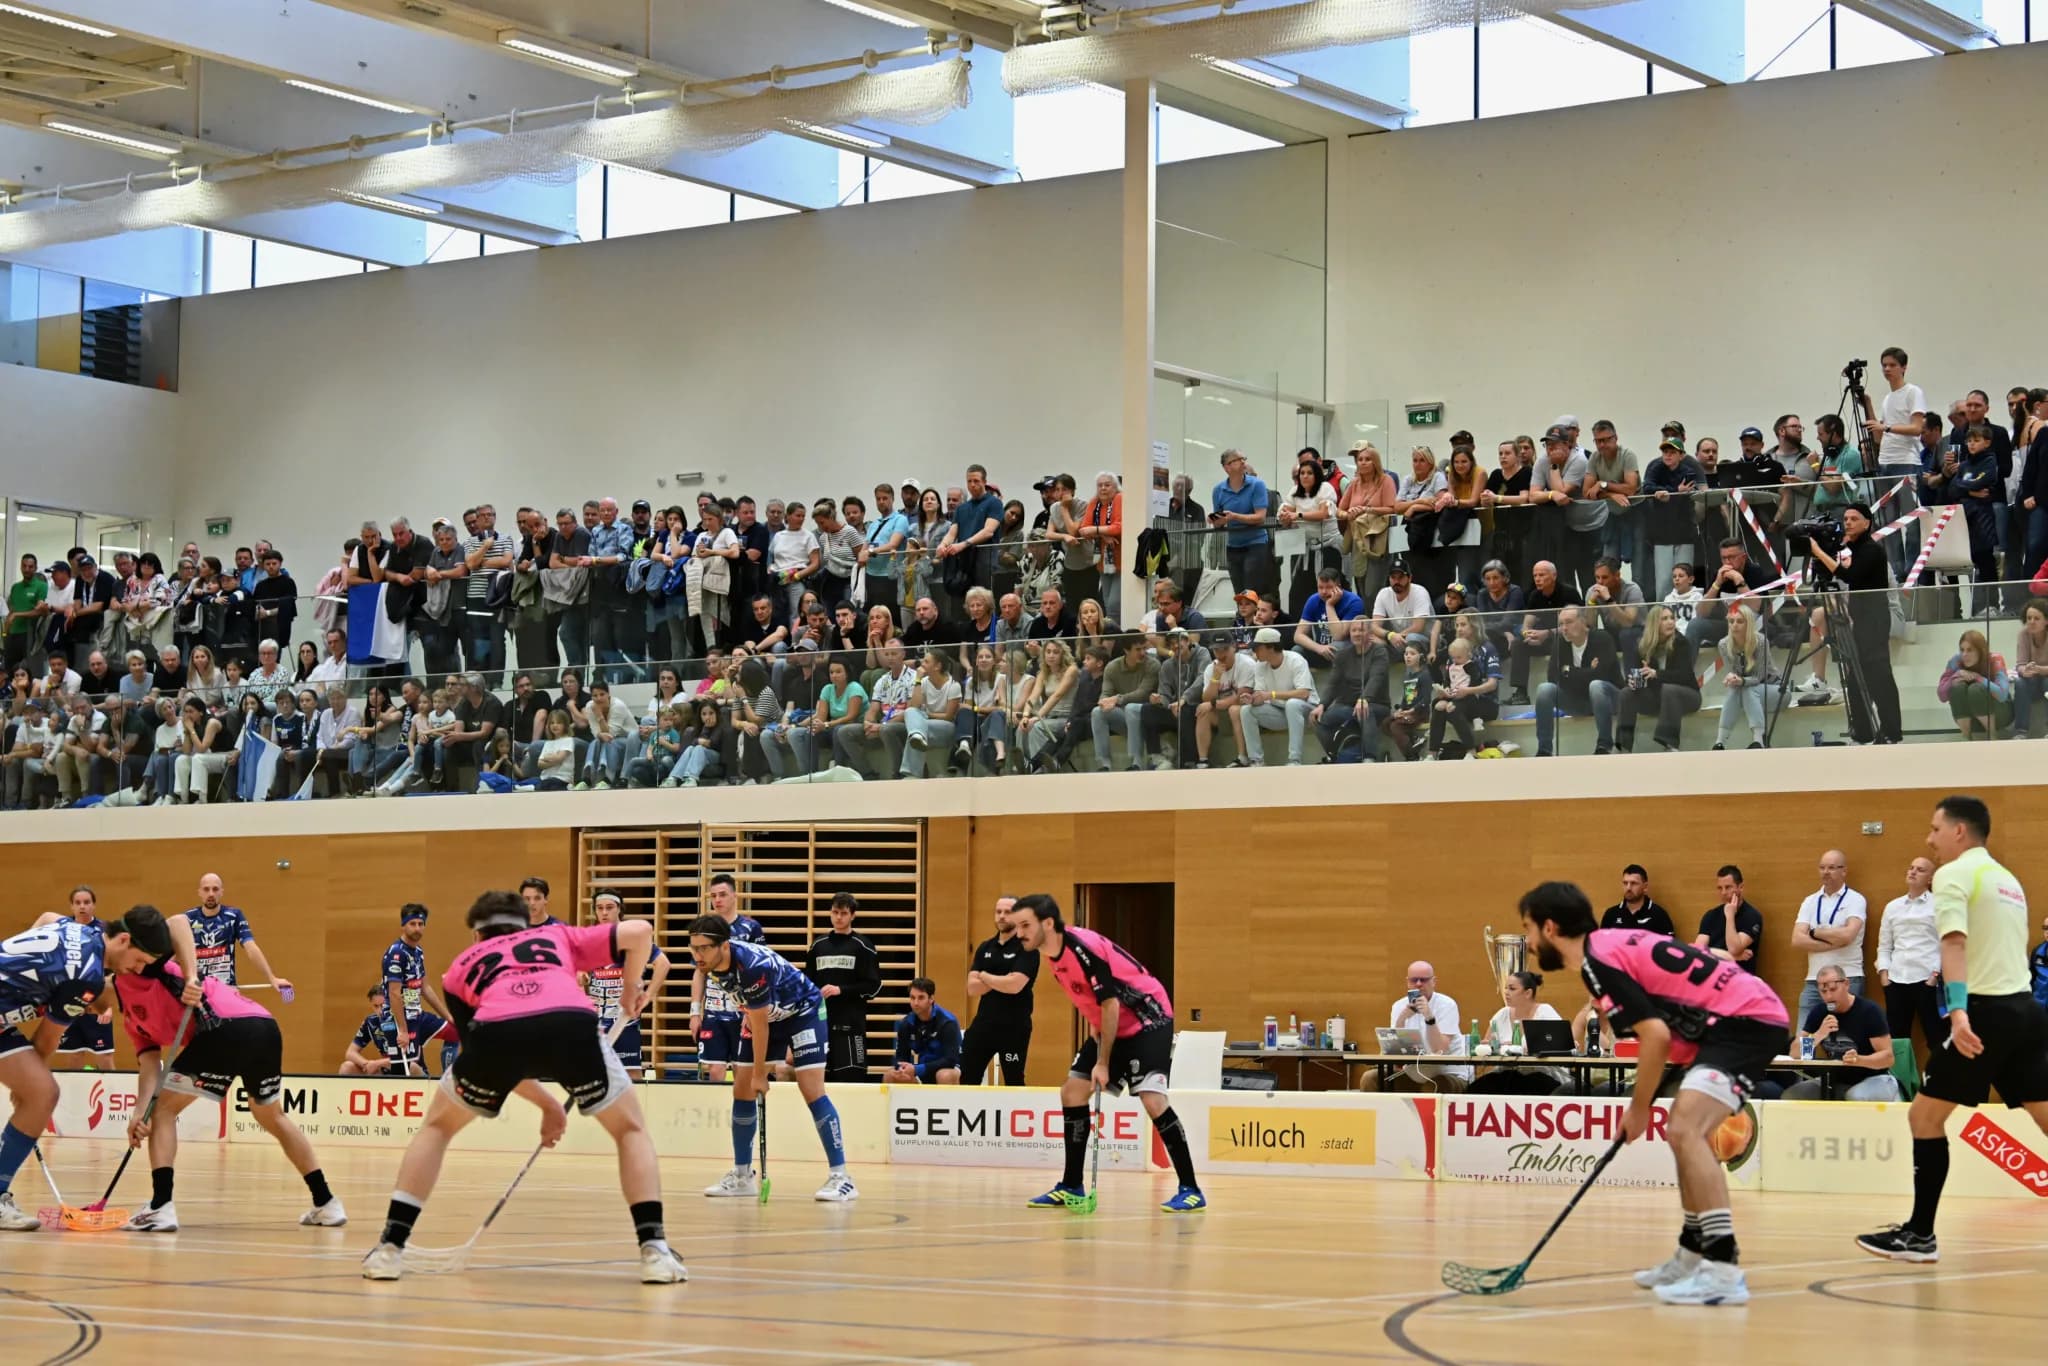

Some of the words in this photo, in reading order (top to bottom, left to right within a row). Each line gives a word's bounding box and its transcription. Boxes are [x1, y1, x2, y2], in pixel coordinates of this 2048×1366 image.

[464, 938, 562, 996] 26
[1651, 940, 1719, 986] 9
[1005, 1053, 1019, 1062] SA
[1006, 1141, 1064, 1150] SEMICONDUC
[1968, 1125, 2026, 1171] ASKÖ
[1535, 1175, 1577, 1185] VILLACH
